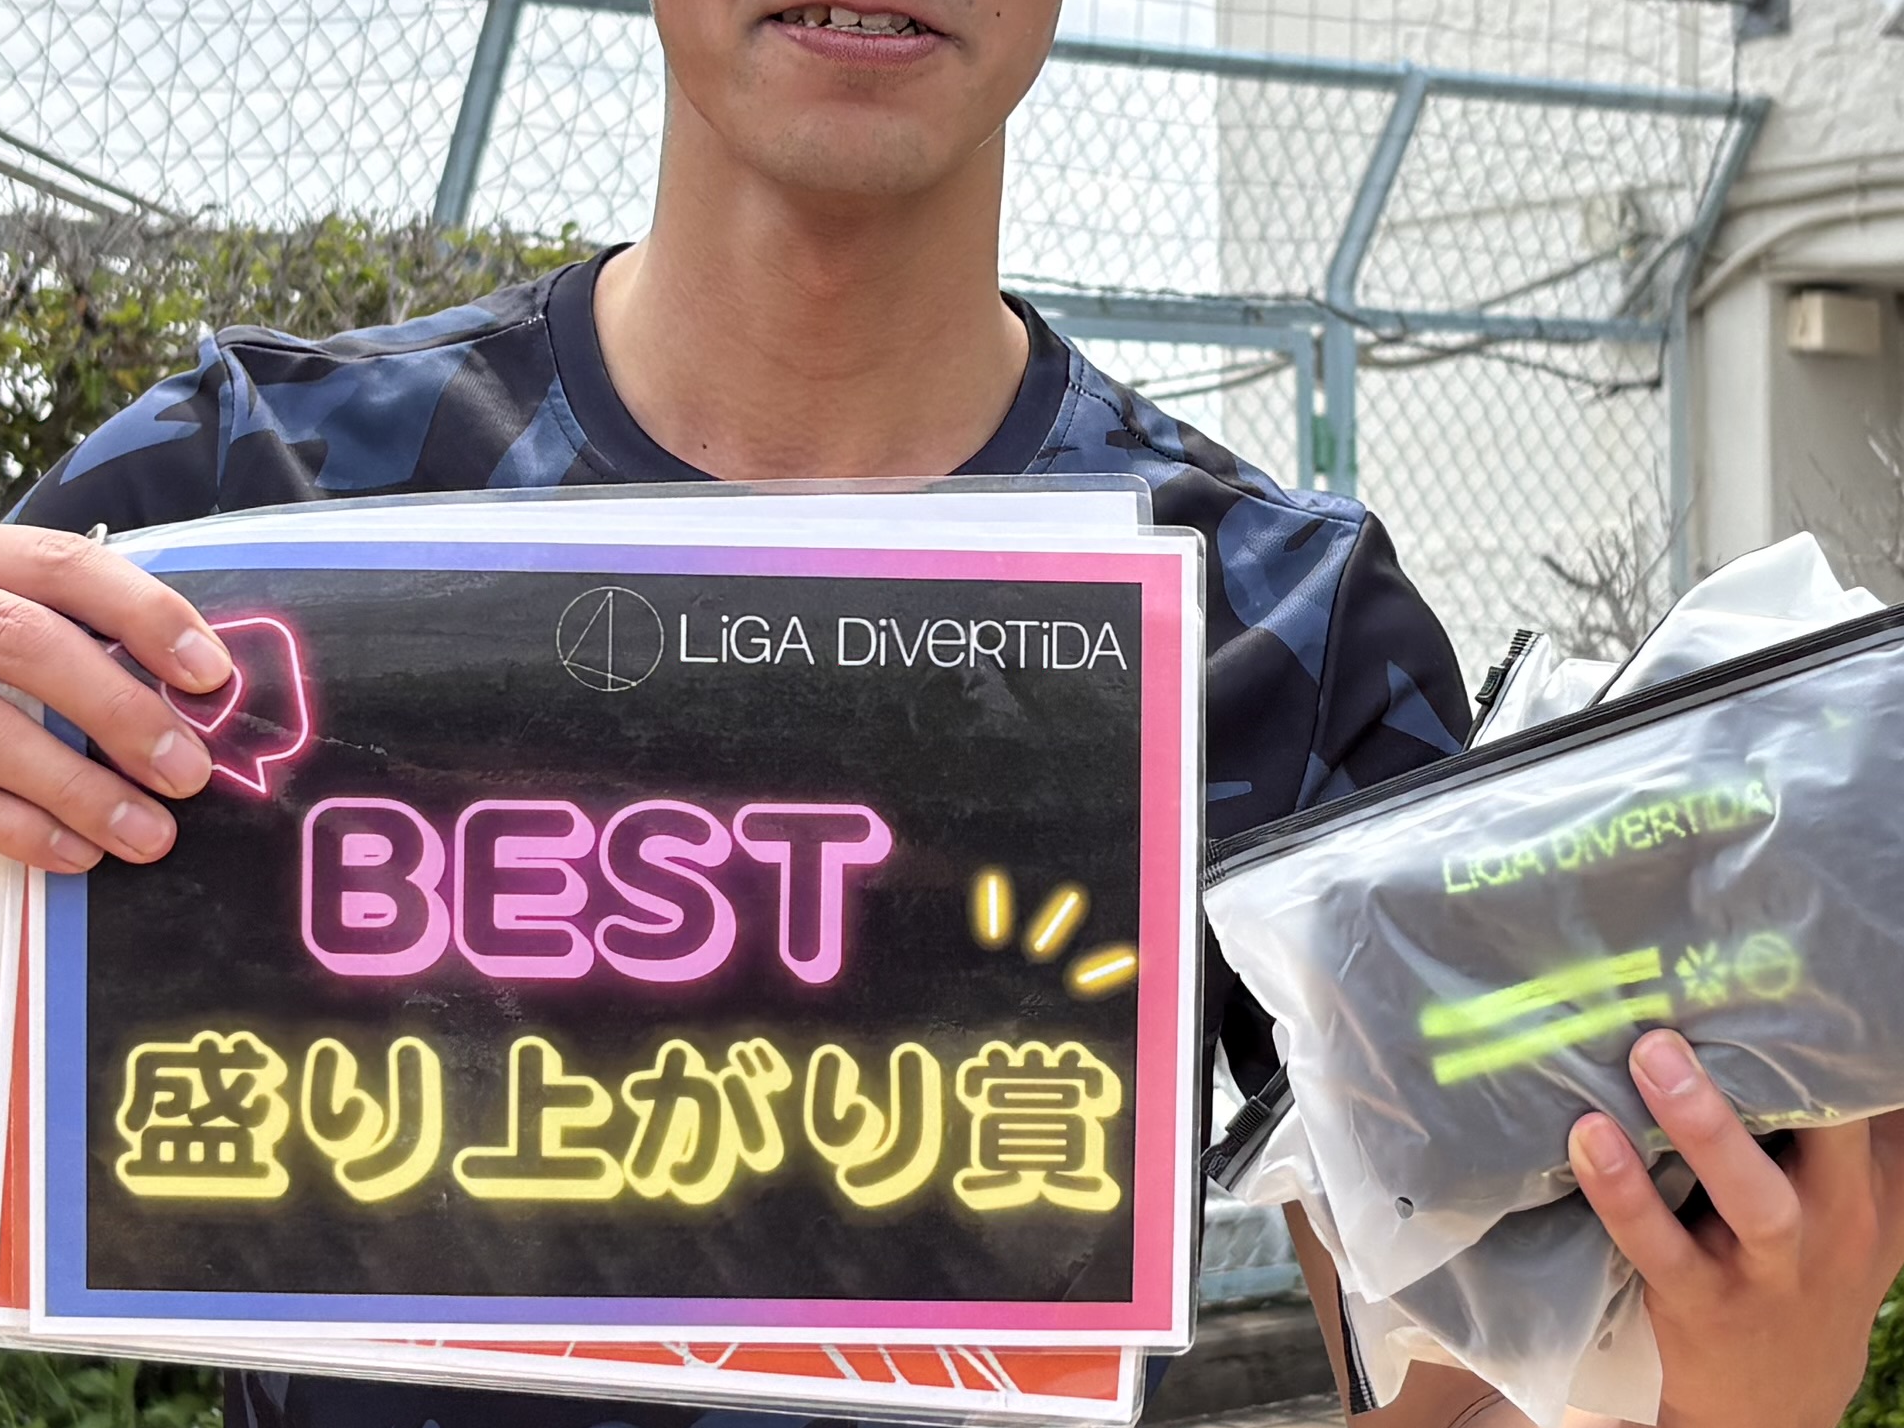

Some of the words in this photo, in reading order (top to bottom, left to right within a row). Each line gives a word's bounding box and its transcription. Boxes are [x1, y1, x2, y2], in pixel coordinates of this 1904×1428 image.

[300, 796, 893, 985] BEST
[114, 1029, 1124, 1214] 盛り上がり賞
